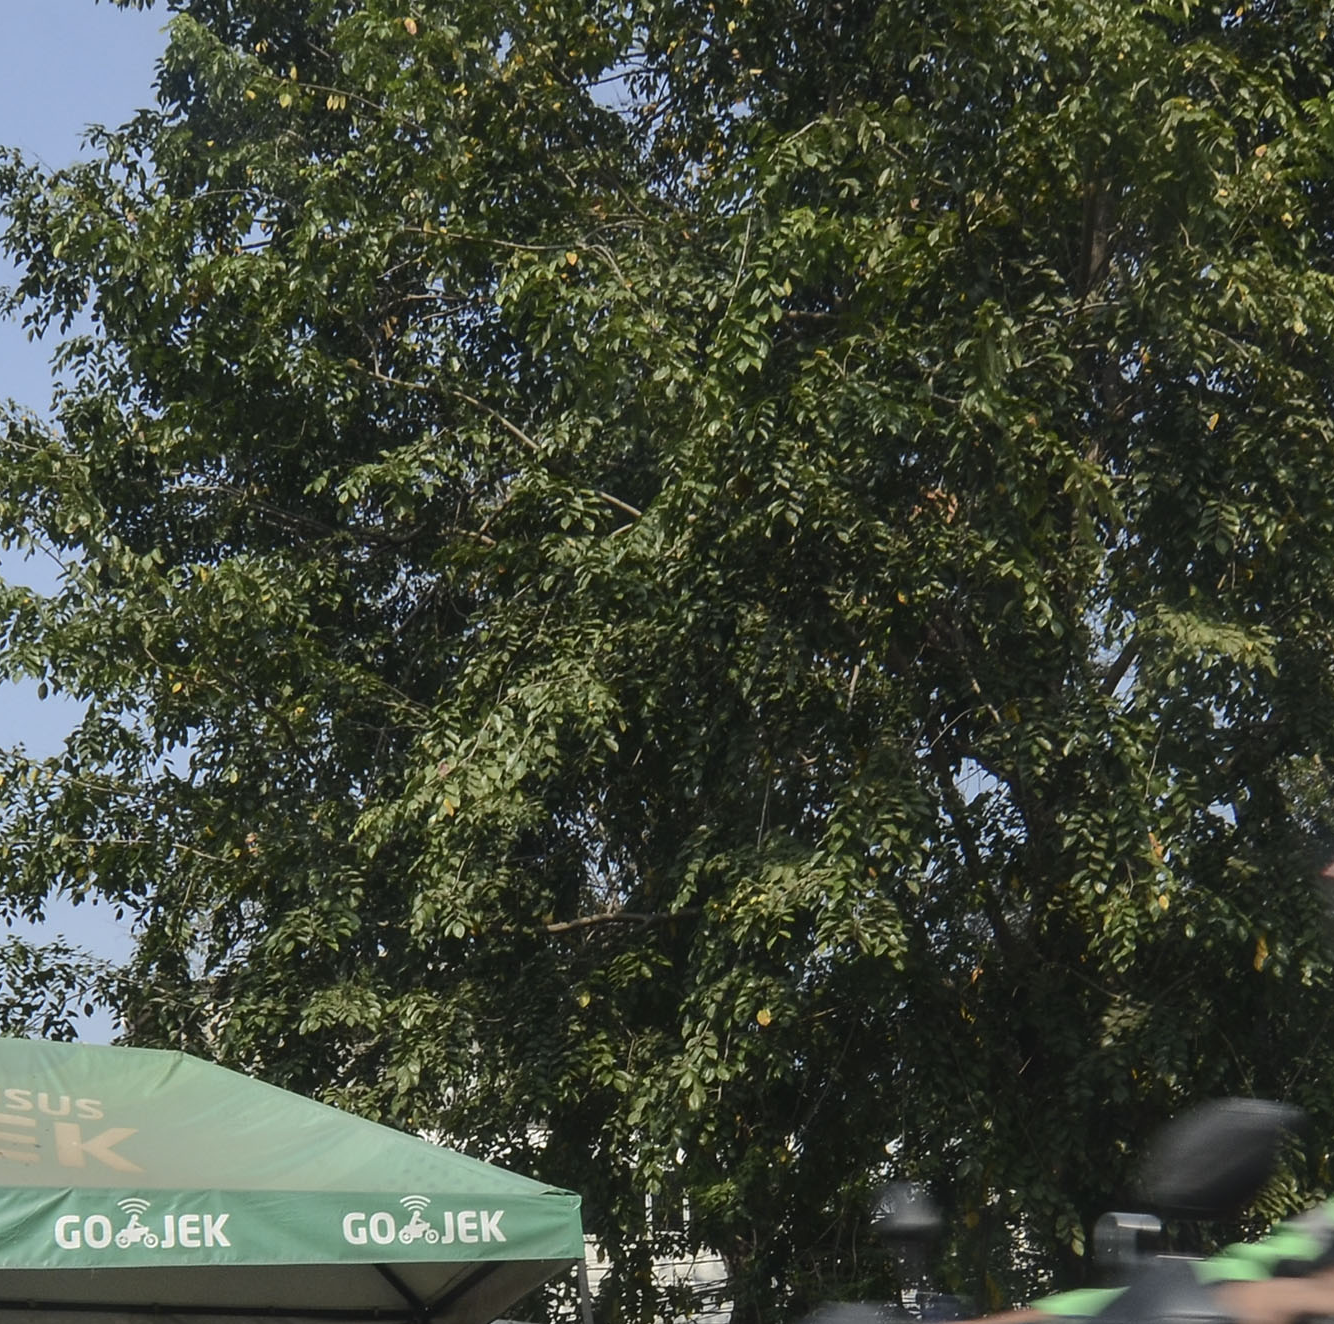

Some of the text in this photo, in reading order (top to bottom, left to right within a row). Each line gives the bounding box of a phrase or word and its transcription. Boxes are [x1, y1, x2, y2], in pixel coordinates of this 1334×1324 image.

[54, 1213, 231, 1250] GO JEK
[342, 1209, 507, 1245] GO JEK
